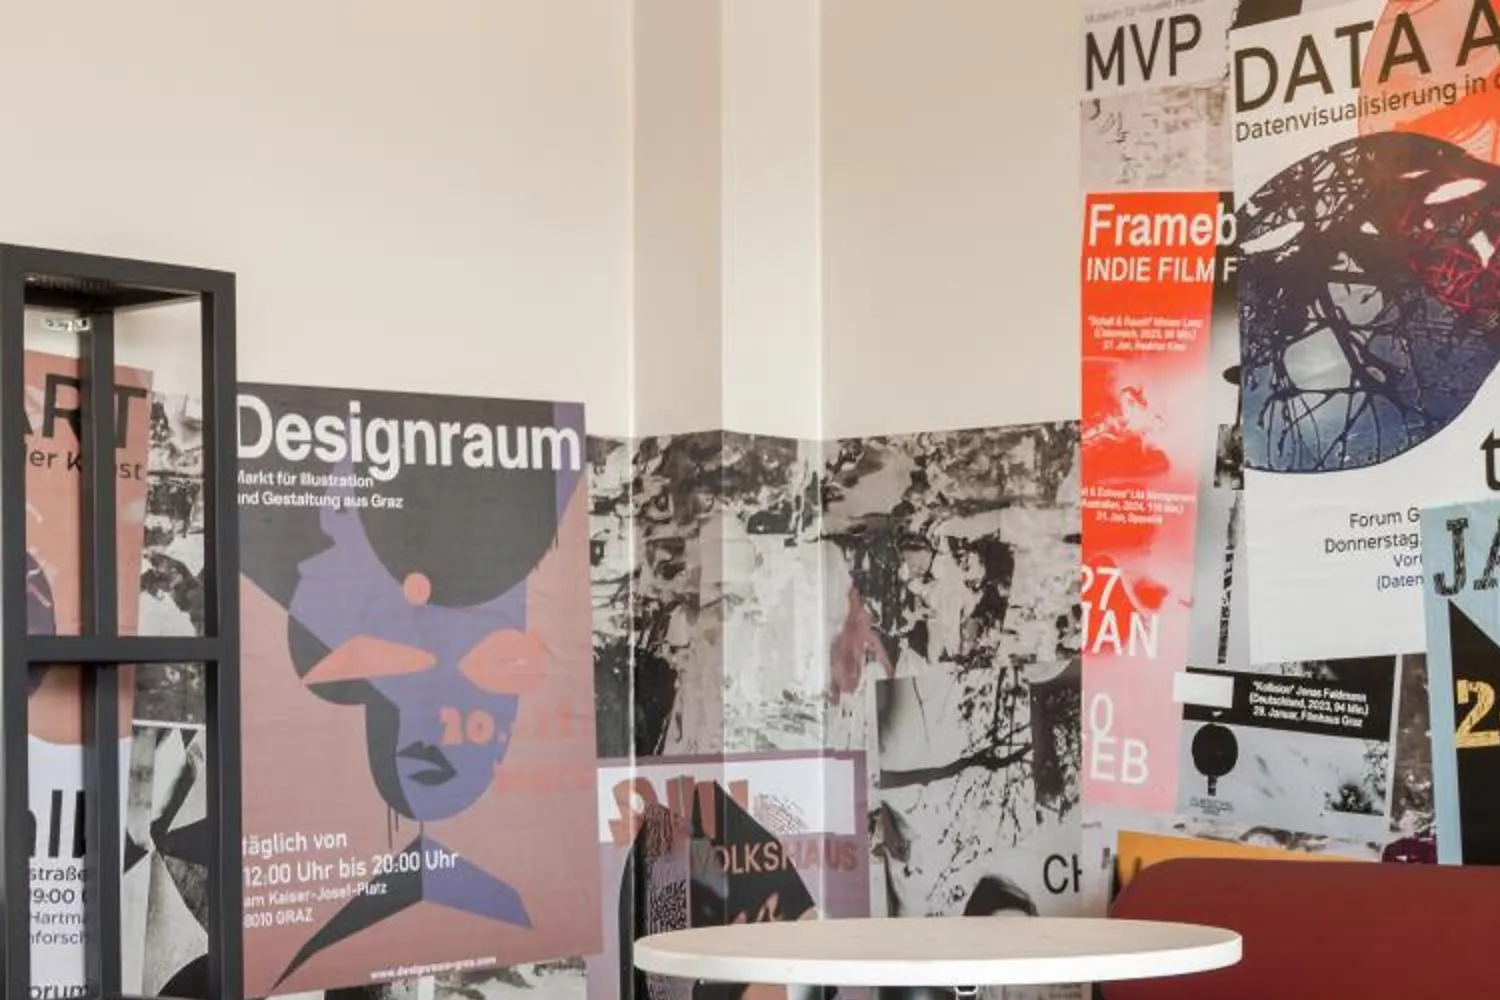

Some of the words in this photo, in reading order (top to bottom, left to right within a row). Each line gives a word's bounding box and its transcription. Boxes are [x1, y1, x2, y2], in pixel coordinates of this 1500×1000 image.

[1086, 13, 1202, 92] MVP
[1234, 12, 1431, 113] DATA
[1235, 82, 1457, 142] Datenvisualisierung
[1465, 75, 1487, 97] in
[1088, 202, 1238, 247] Frameb
[1086, 256, 1152, 283] INDIE
[1157, 256, 1216, 283] FILM
[237, 394, 582, 481] Designraum
[277, 471, 297, 486] für
[300, 471, 374, 489] Illustration
[262, 491, 341, 511] Gestaltung
[344, 496, 368, 508] aus
[371, 494, 404, 509] Graz
[1349, 510, 1402, 529] Forum
[1324, 532, 1419, 553] Donnerstag
[242, 832, 307, 859] täglich
[313, 832, 347, 850] von
[243, 865, 291, 887] 12:00
[297, 862, 334, 883] Uhr
[339, 857, 367, 877] bis
[373, 852, 420, 875] 20:00
[425, 849, 459, 869] Uhr
[277, 908, 314, 925] GRAZ
